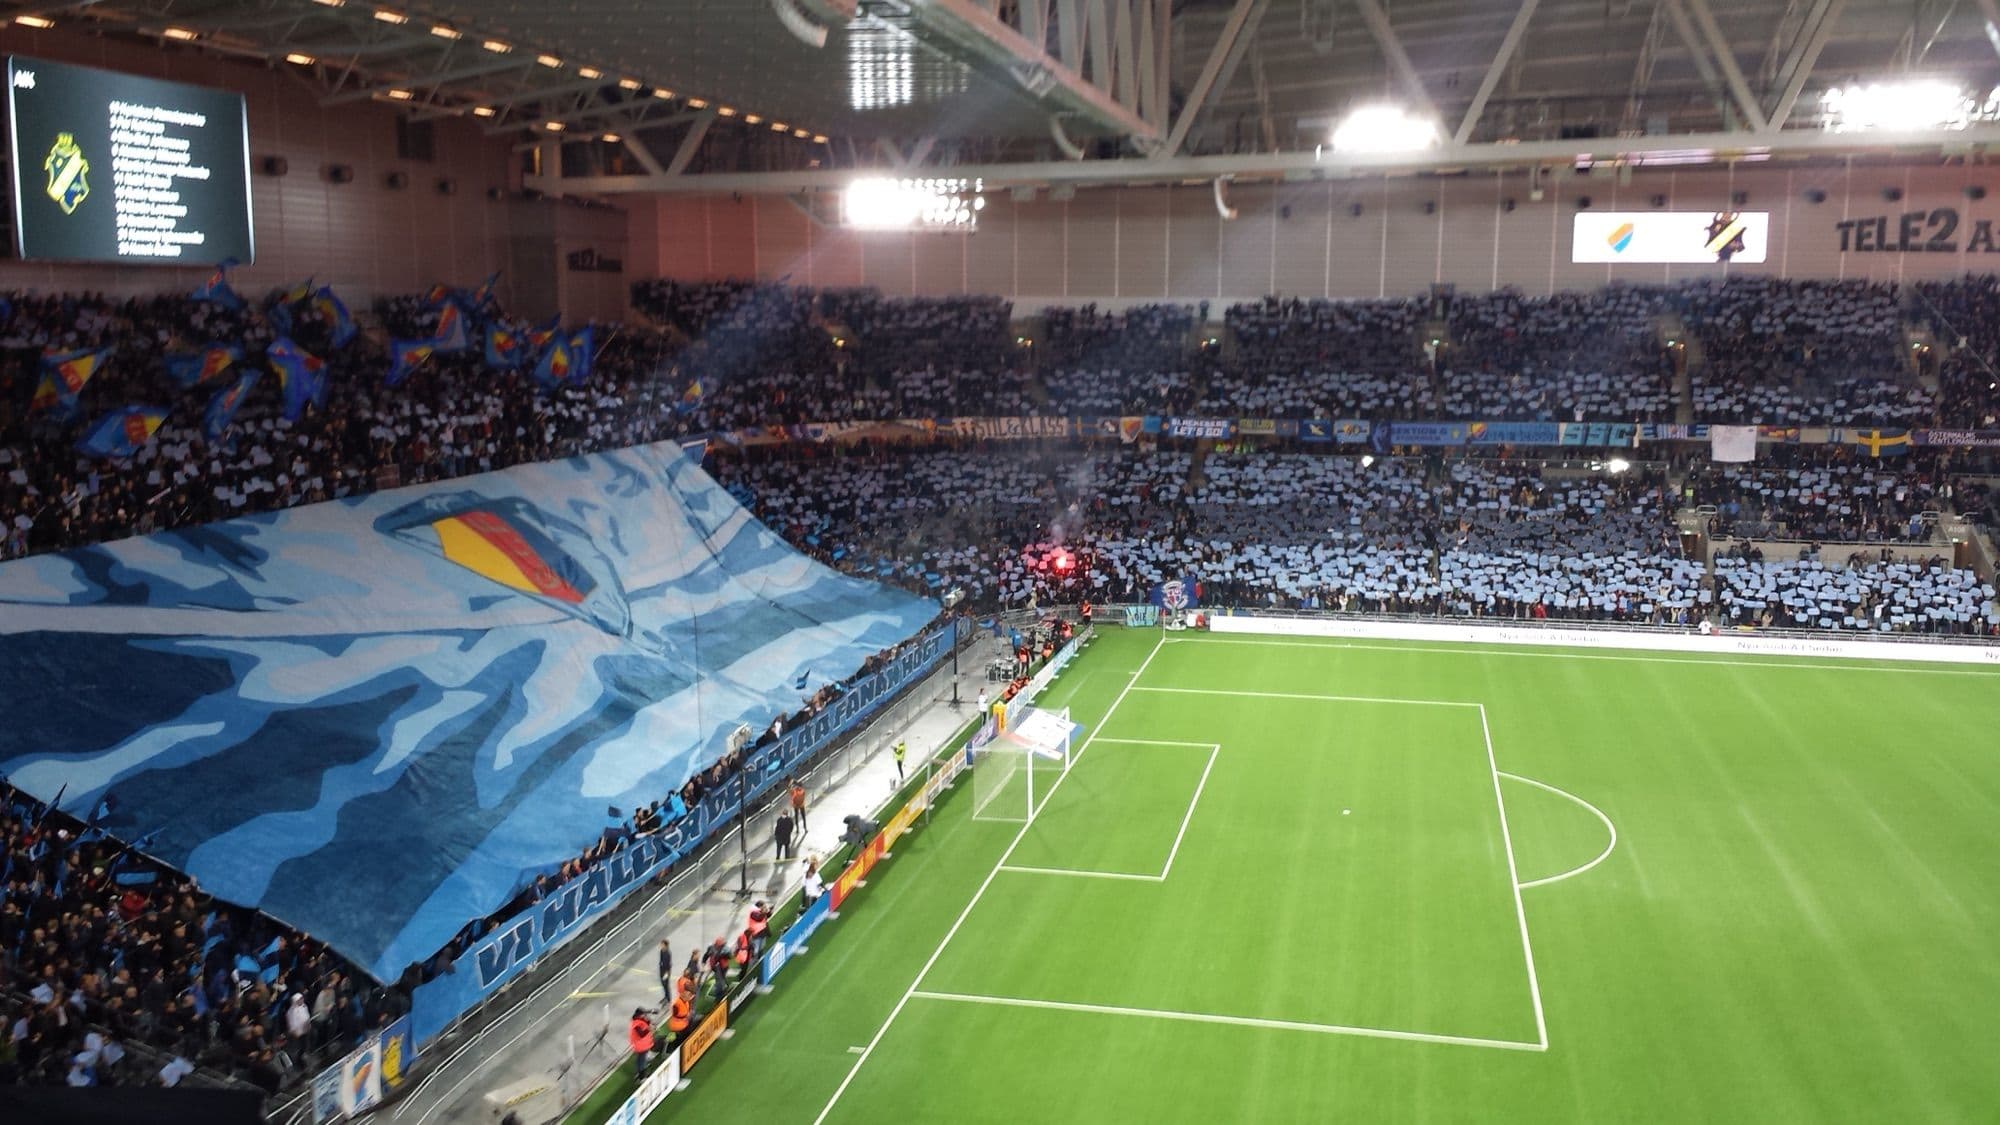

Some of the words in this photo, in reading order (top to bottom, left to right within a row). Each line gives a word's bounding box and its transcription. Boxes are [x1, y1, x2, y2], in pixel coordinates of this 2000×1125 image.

[1836, 208, 1959, 253] TELE2
[1966, 219, 2000, 253] A
[1173, 426, 1203, 437] LET'S
[477, 916, 534, 989] VI
[832, 662, 900, 730] FANAN
